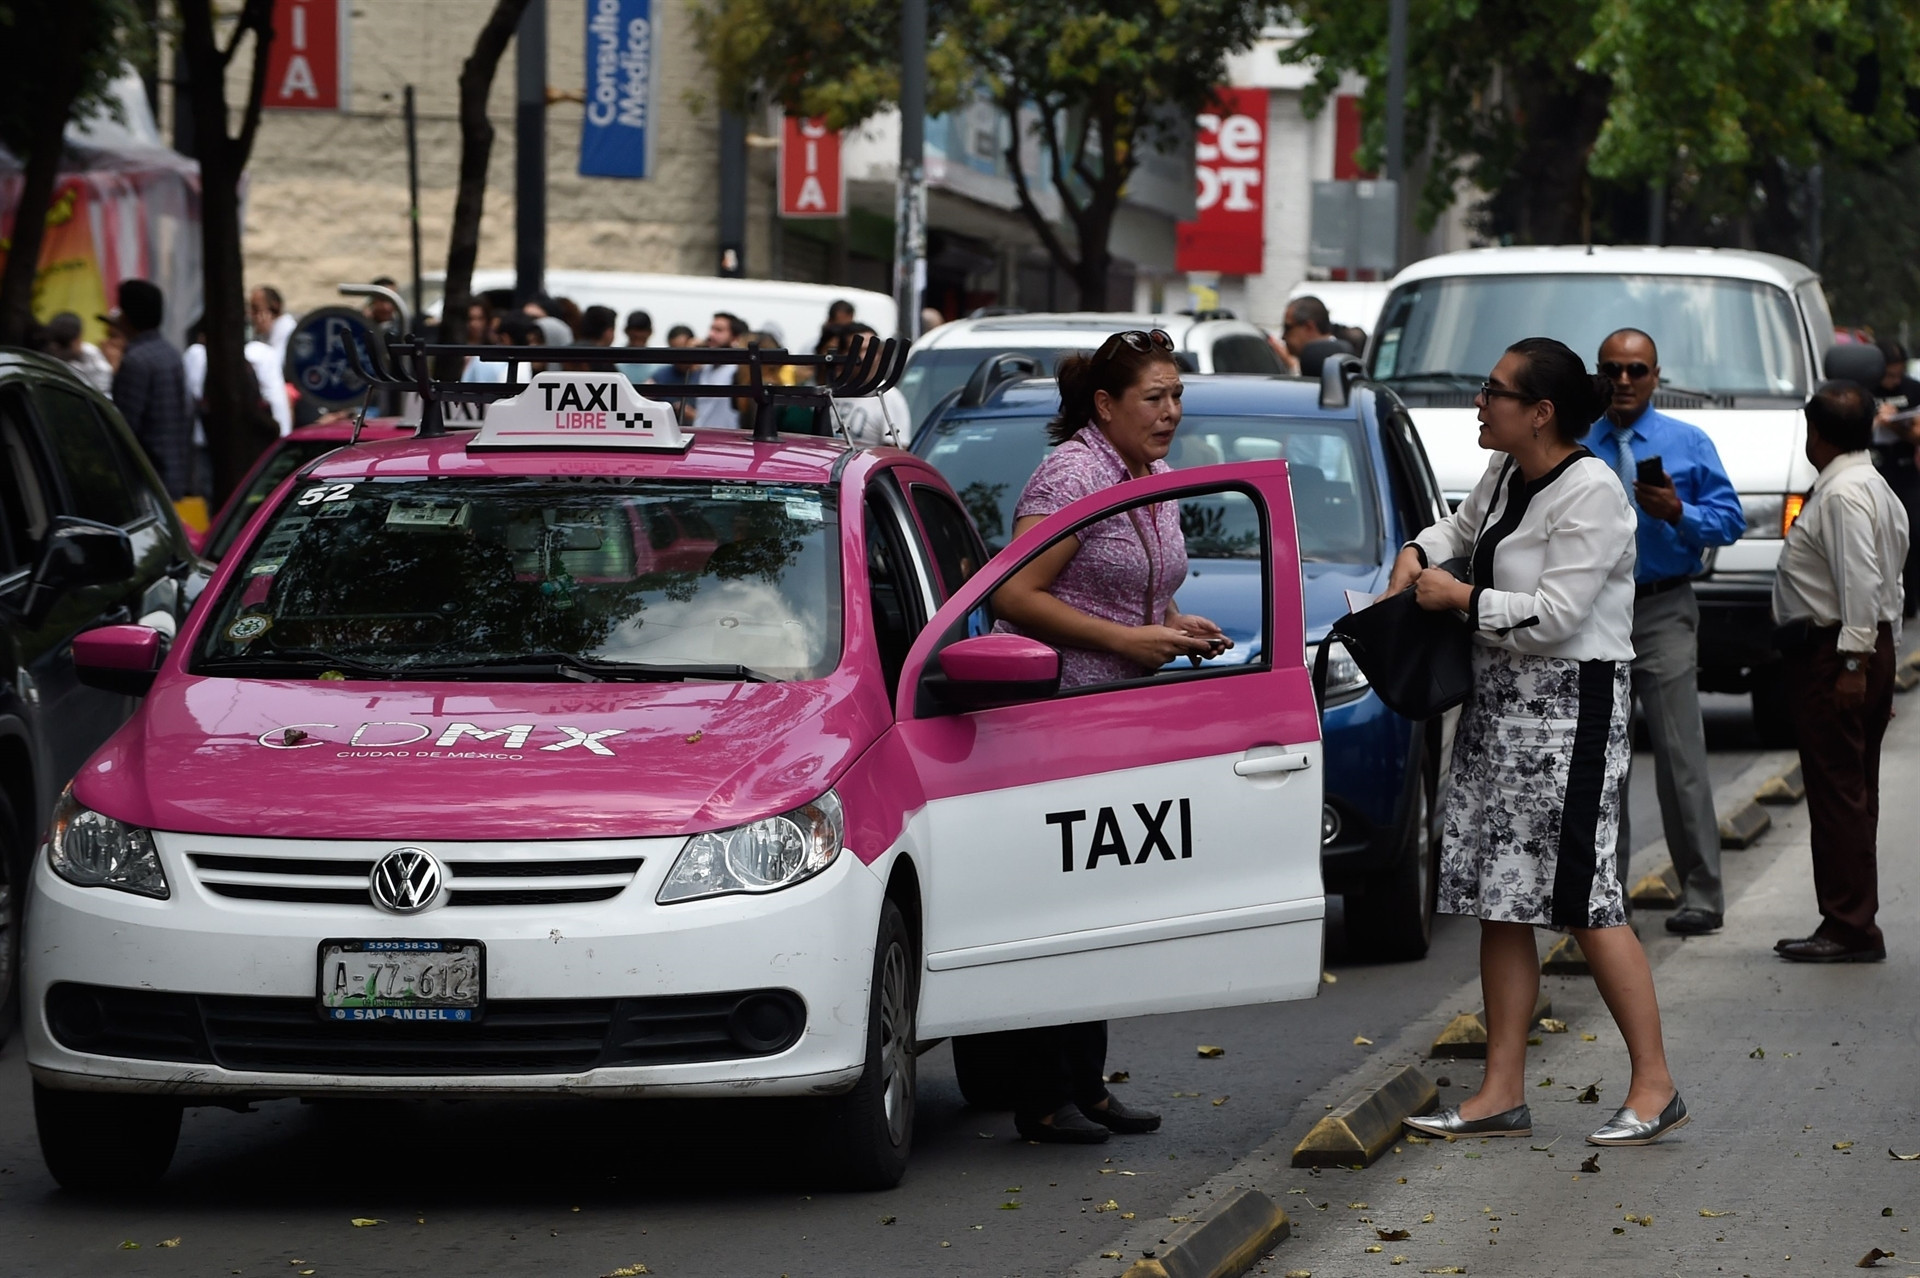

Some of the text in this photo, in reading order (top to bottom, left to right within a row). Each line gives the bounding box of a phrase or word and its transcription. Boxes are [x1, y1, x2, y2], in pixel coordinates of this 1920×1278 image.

[617, 17, 651, 128] Médico
[538, 383, 618, 411] TAXI
[555, 413, 607, 429] LIBRE
[298, 483, 355, 506] 52
[257, 722, 627, 758] CDMX
[447, 750, 524, 761] MÉXICO
[1045, 798, 1193, 872] TAXI
[368, 941, 439, 950] 5593-58-33
[334, 961, 468, 998] A-77-612
[353, 1009, 387, 1020] SAN
[393, 1009, 448, 1020] ANGEL
